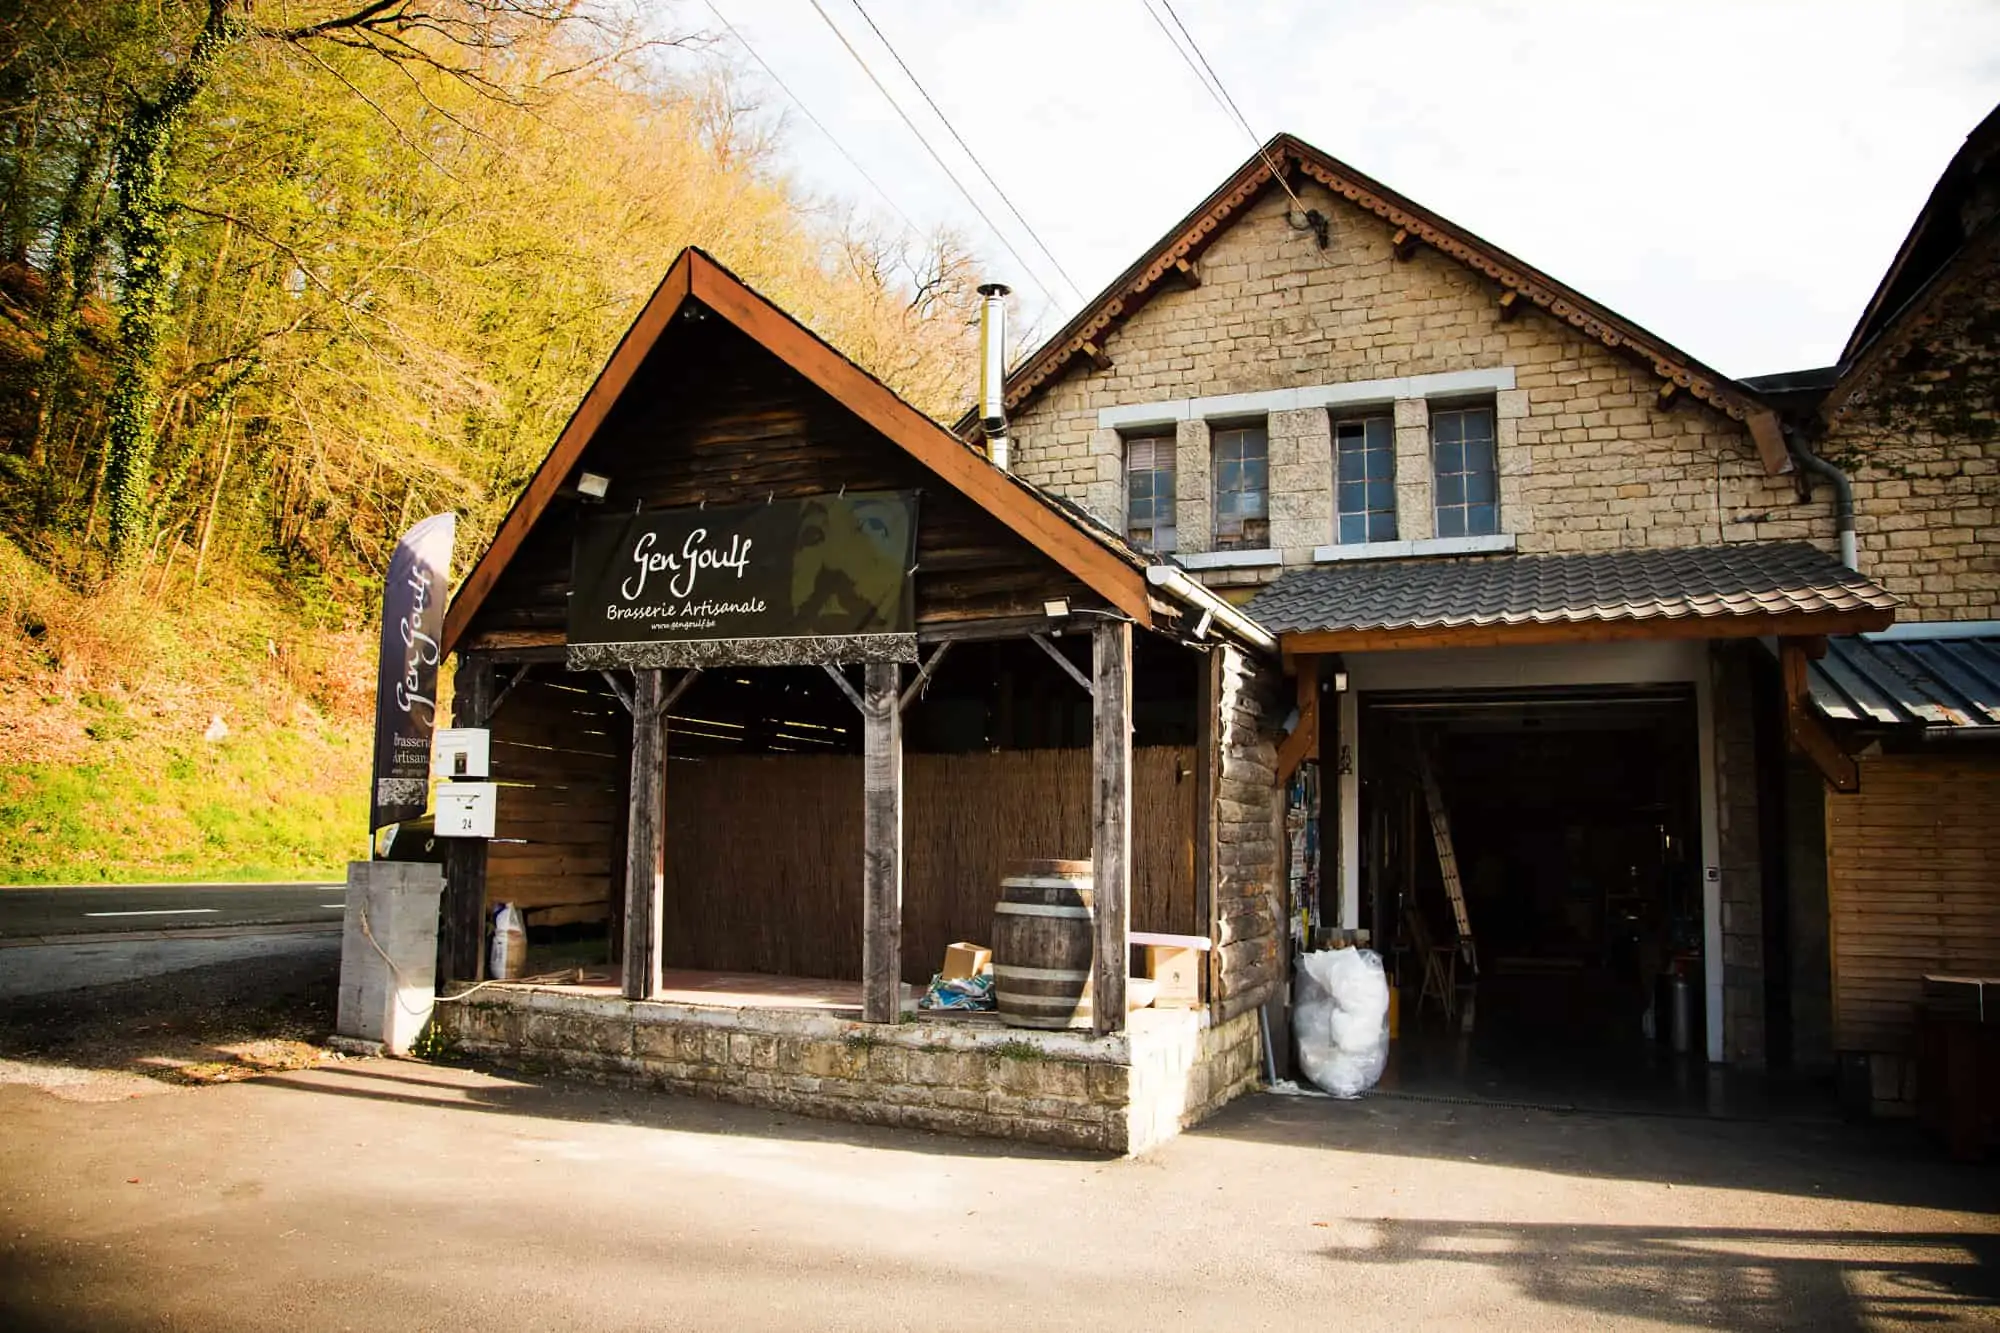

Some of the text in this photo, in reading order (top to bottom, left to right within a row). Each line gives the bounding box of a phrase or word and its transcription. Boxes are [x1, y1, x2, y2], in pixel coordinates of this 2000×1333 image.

[621, 528, 753, 600] Gen Goulf
[400, 565, 439, 667] Goulf
[606, 597, 767, 621] Brasserie Artisanale
[651, 619, 716, 631] www.gengoulf.be
[396, 650, 435, 728] Gen
[462, 818, 472, 830] 24
